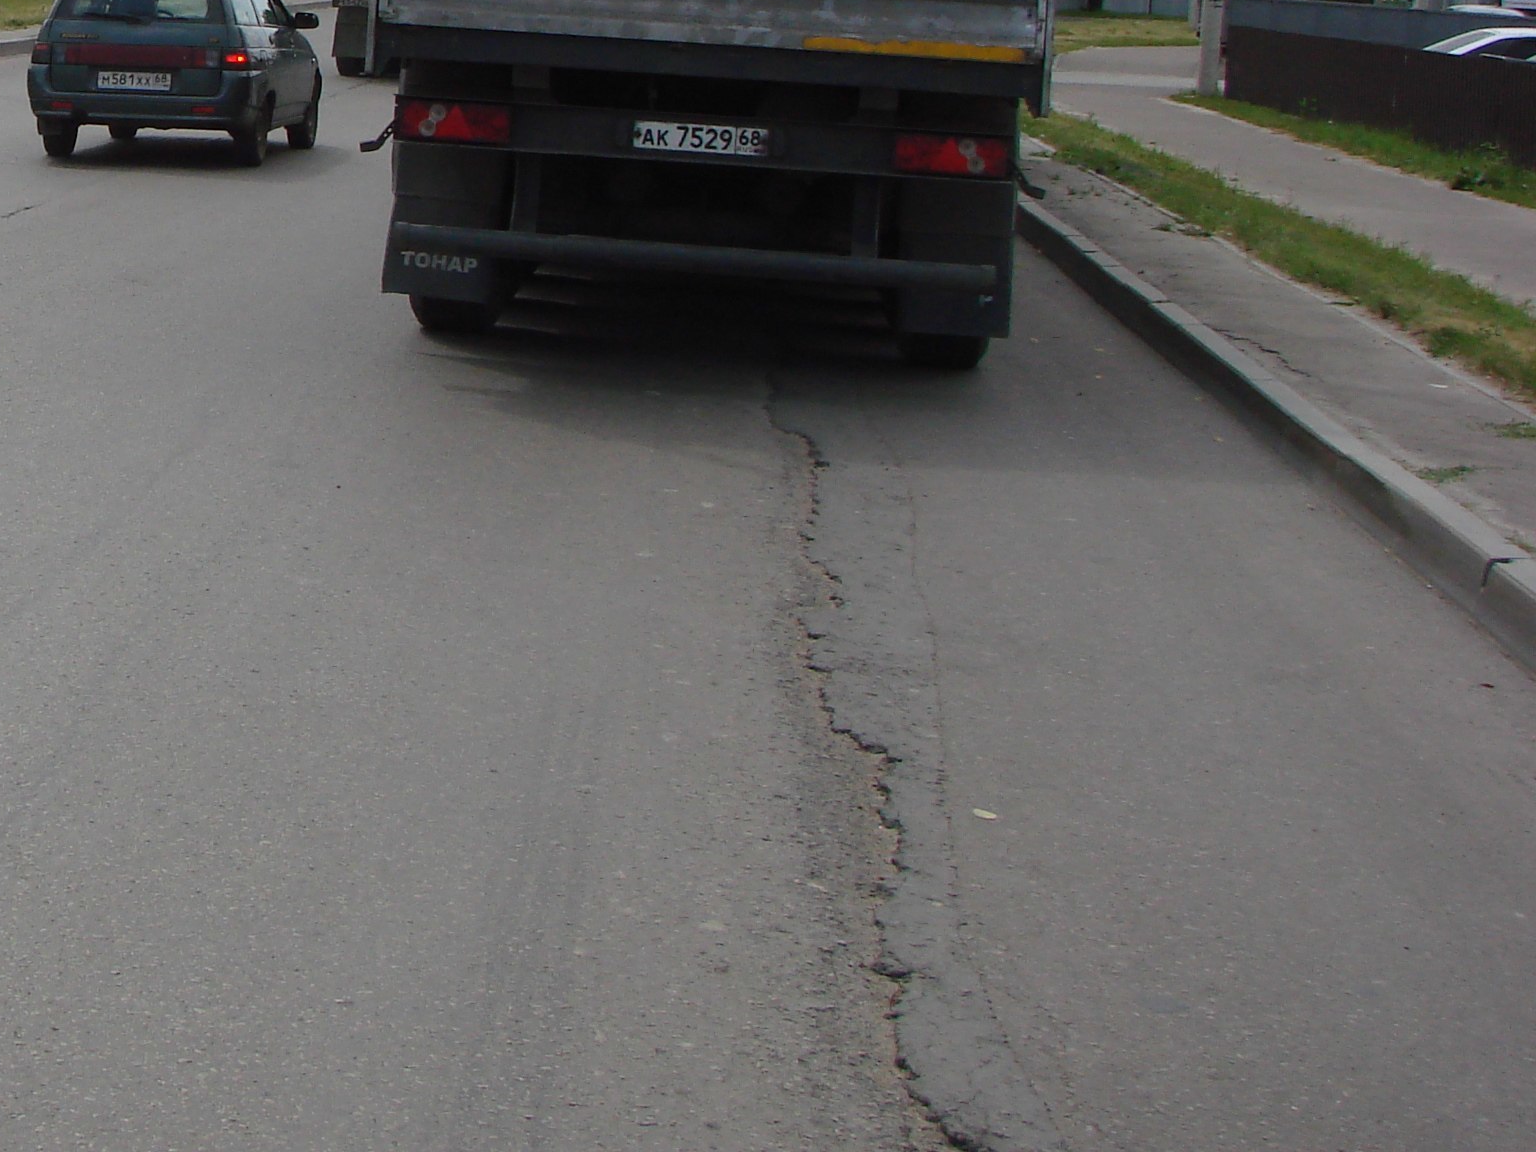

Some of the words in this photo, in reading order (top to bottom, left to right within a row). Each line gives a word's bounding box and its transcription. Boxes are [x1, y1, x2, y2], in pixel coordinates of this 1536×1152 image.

[641, 127, 669, 147] АК
[676, 125, 733, 151] 7529
[738, 128, 762, 147] 68
[400, 250, 478, 274] ТОНАР
